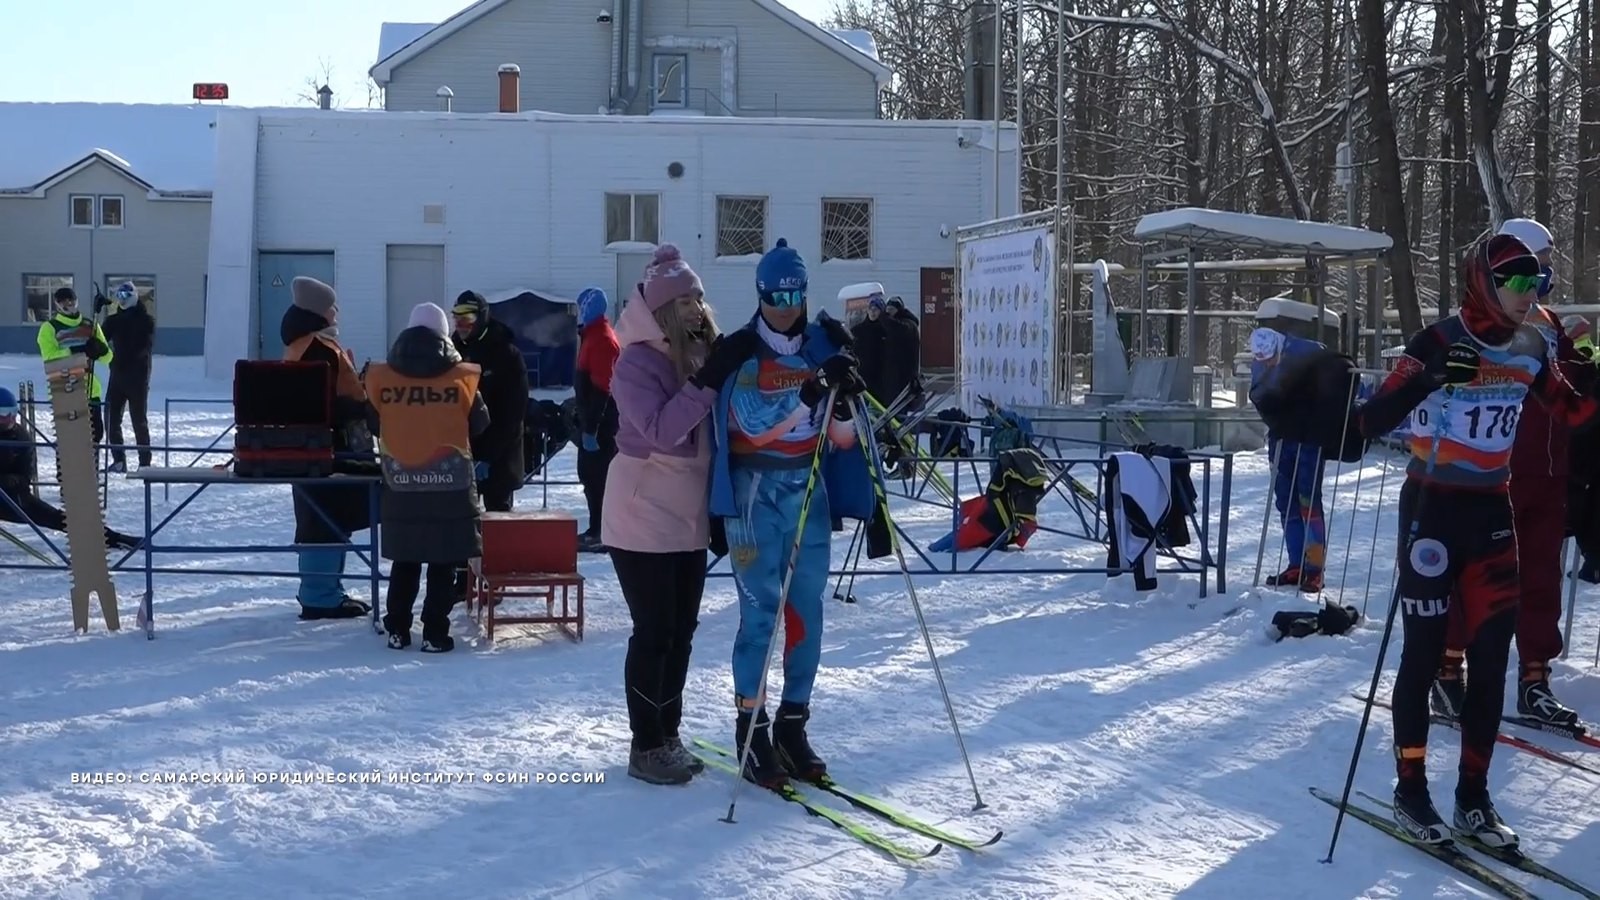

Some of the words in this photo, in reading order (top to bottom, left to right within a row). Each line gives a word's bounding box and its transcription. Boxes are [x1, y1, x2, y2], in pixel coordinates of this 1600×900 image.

[380, 386, 460, 406] СУДЬЯ
[1464, 405, 1517, 439] 170
[413, 471, 454, 484] чайка
